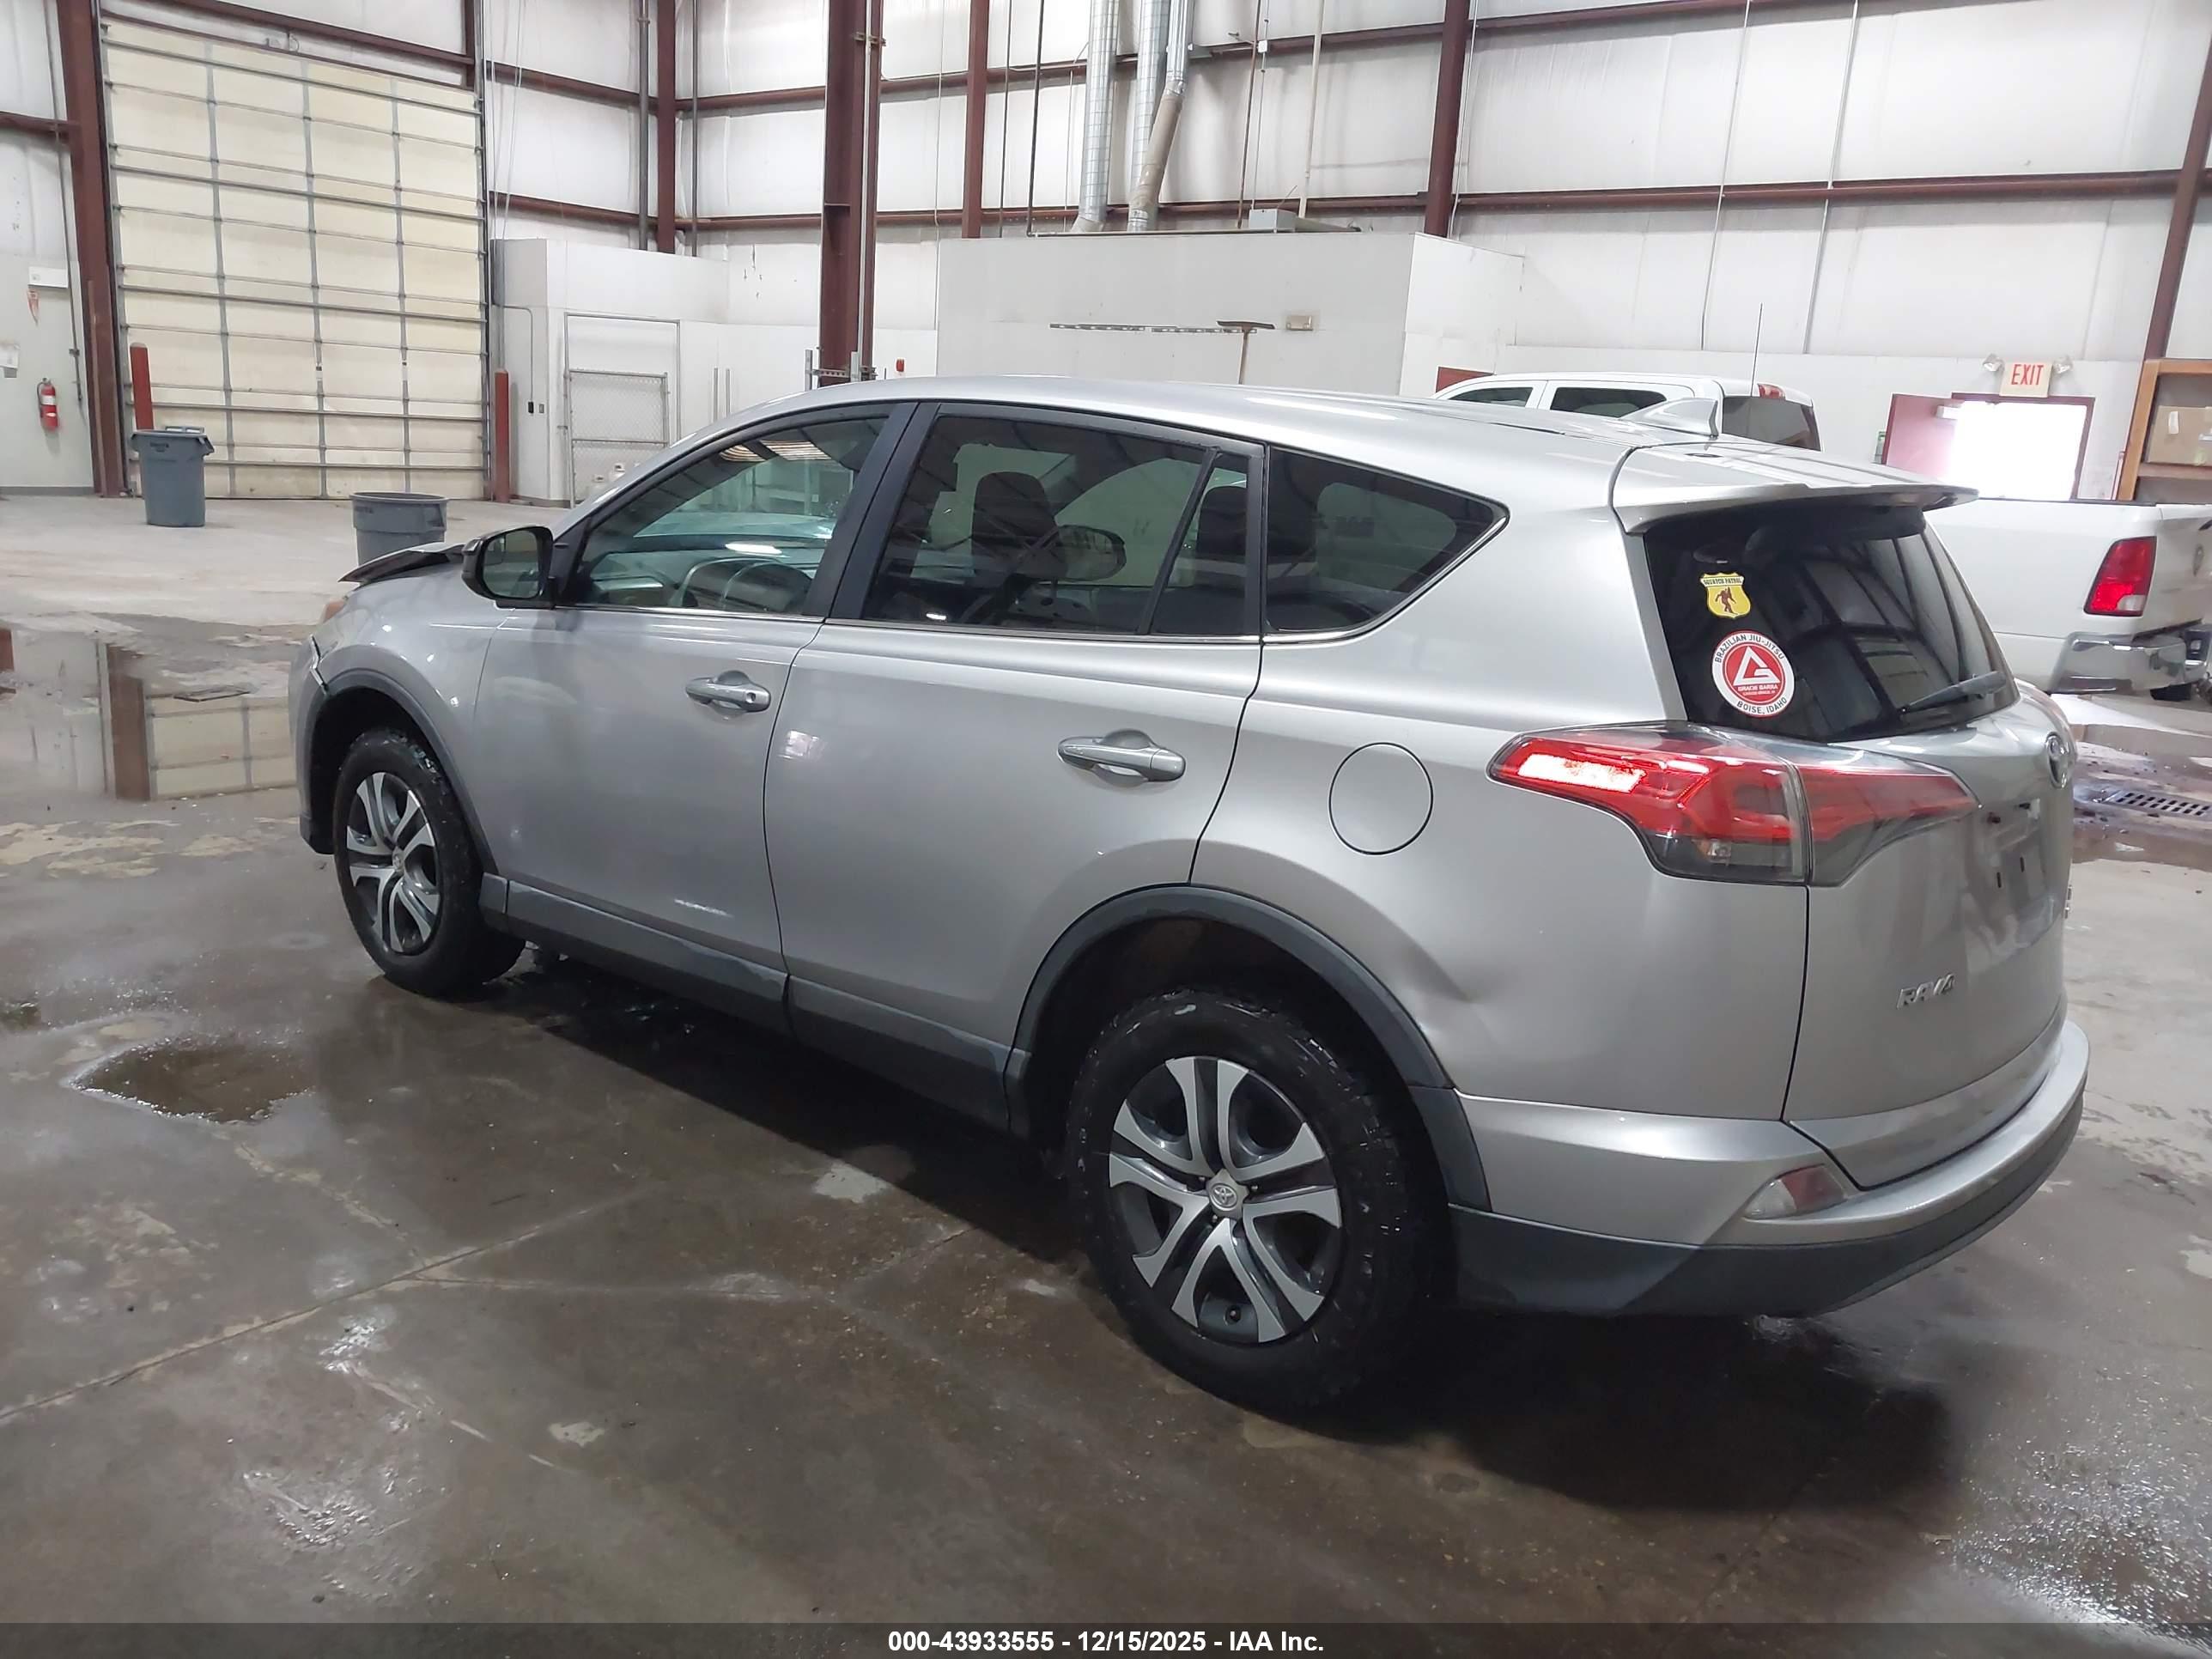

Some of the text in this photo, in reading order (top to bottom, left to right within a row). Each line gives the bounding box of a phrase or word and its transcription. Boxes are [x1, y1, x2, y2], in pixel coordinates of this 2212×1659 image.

[2011, 363, 2044, 385] EXIT
[1714, 634, 1785, 663] BRAZILIAN JIU-JITSU
[1737, 696, 1788, 714] BOISE, IDAHO
[1895, 973, 1955, 1010] RAV4
